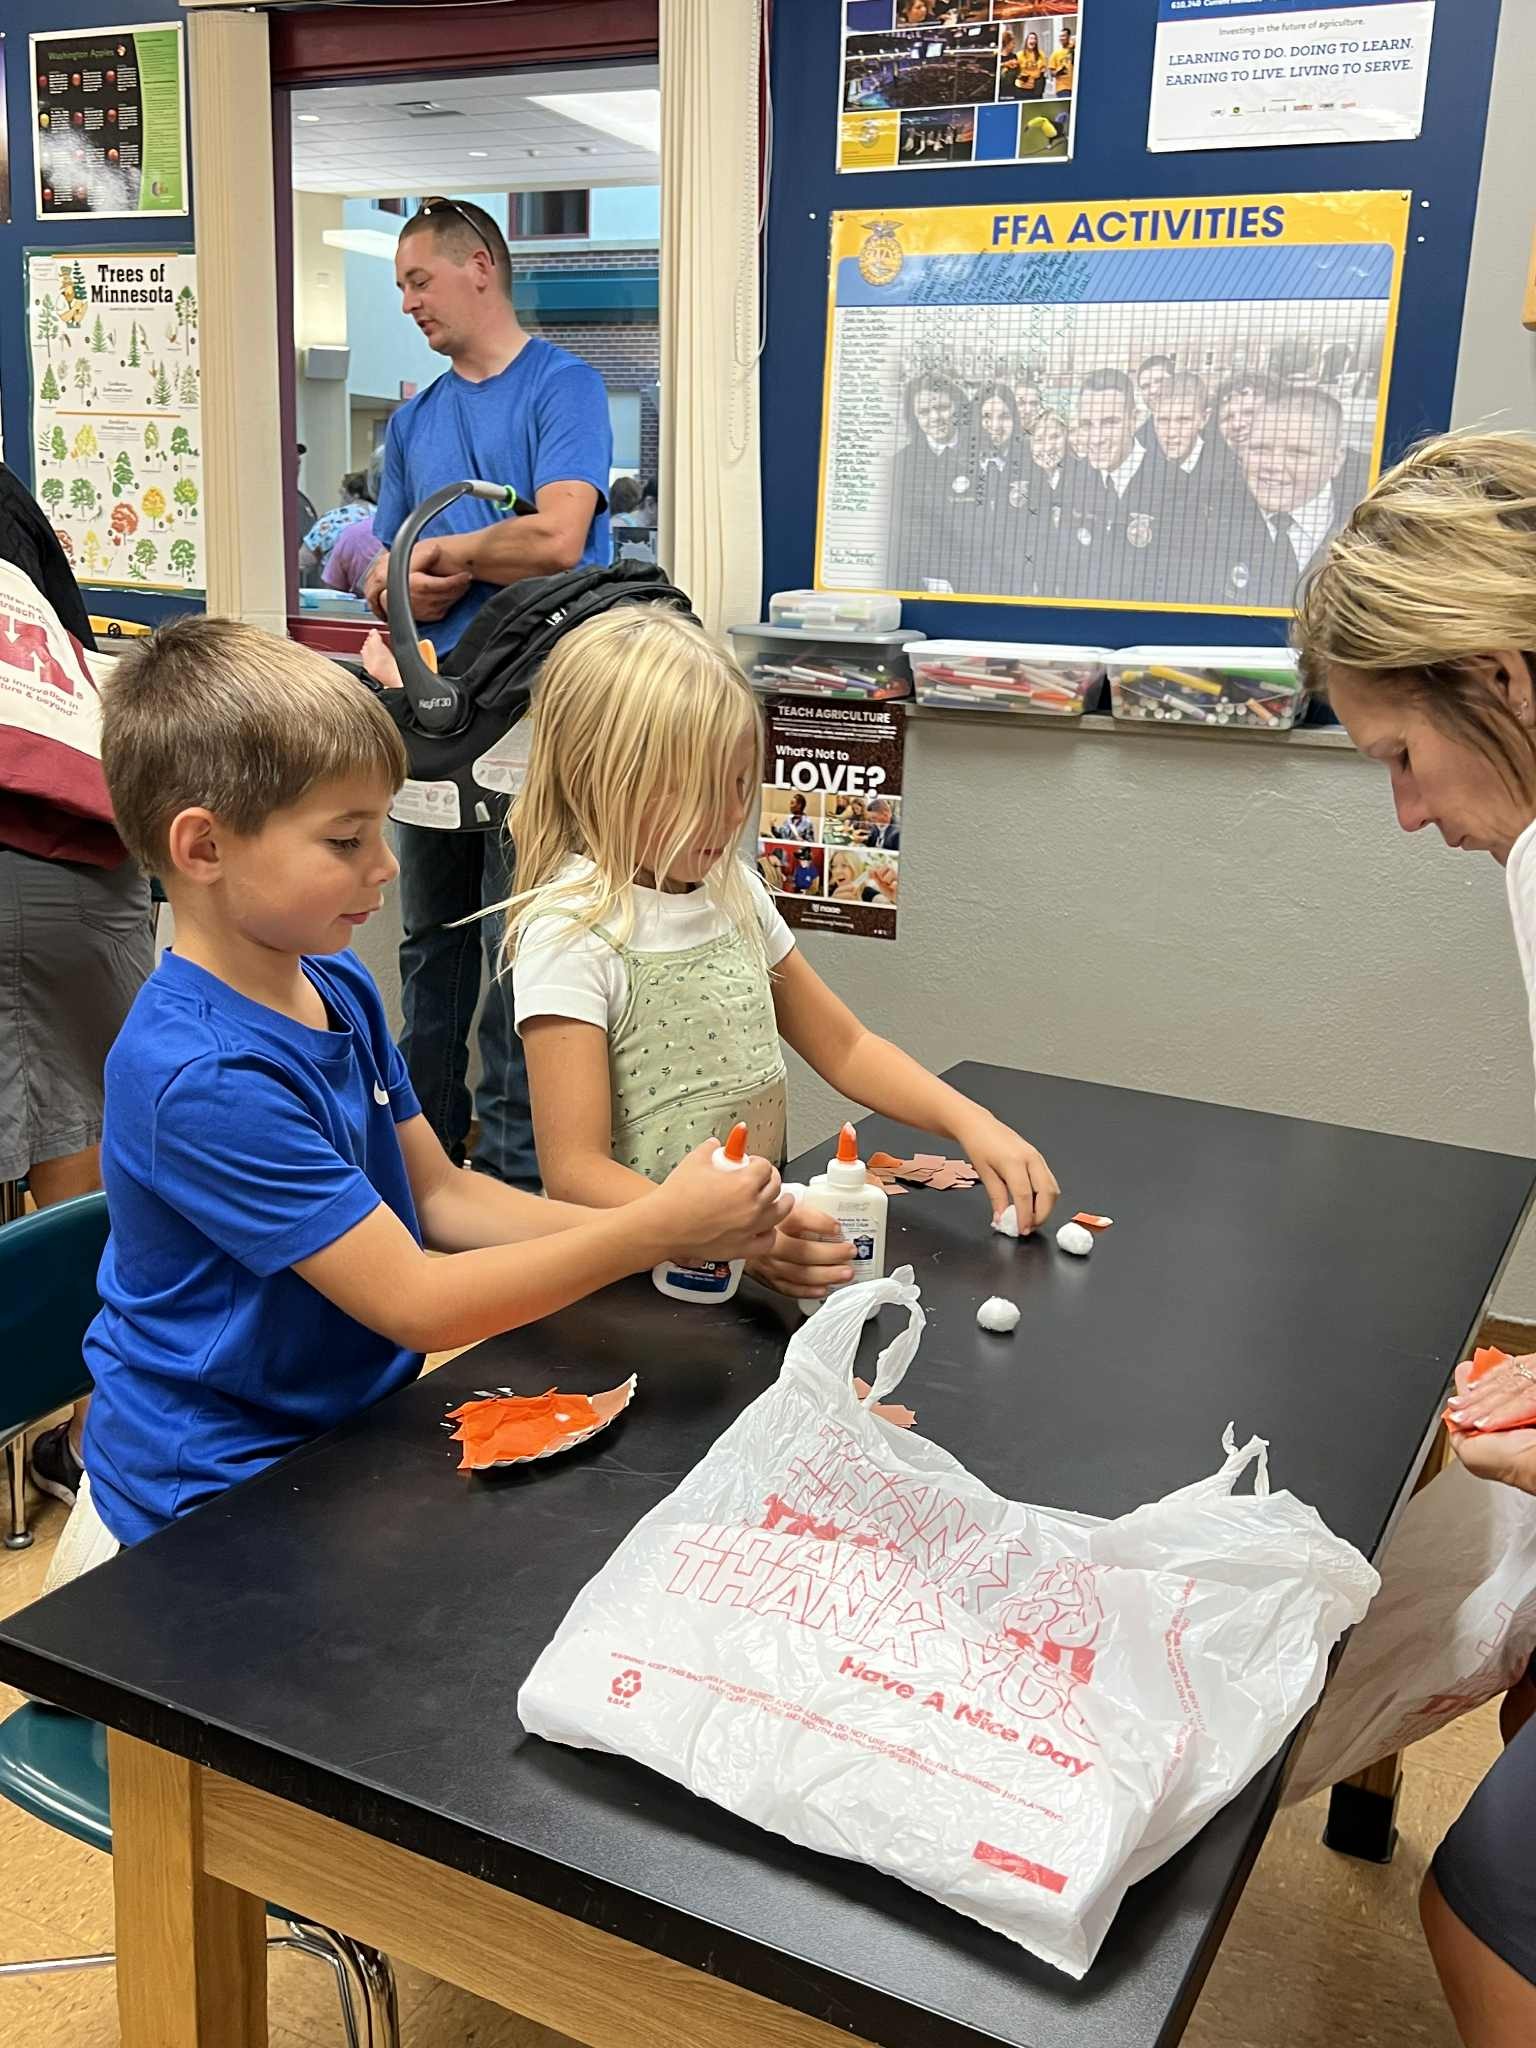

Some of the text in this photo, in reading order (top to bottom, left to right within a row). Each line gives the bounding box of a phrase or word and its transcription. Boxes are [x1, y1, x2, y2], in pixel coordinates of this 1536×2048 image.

[1219, 18, 1366, 36] Investing in the future of agriculture.
[1169, 38, 1414, 66] LEARNING TO DO. DOING TO LEARN.
[1166, 59, 1413, 86] EARNING TO LIVE. LIVING TO SERVE.
[991, 206, 1285, 246] FFA ACTIVITIES
[98, 264, 165, 282] Trees of
[91, 285, 173, 303] Minnesota
[13, 678, 66, 705] innovation
[778, 706, 891, 723] TEACH AGRICULTURE
[775, 745, 849, 761] What's Not to
[775, 758, 886, 798] LOVE?
[665, 1540, 945, 1668] THANK
[838, 1655, 1094, 1778] Have A Nice Day
[849, 1728, 868, 1740] NOT
